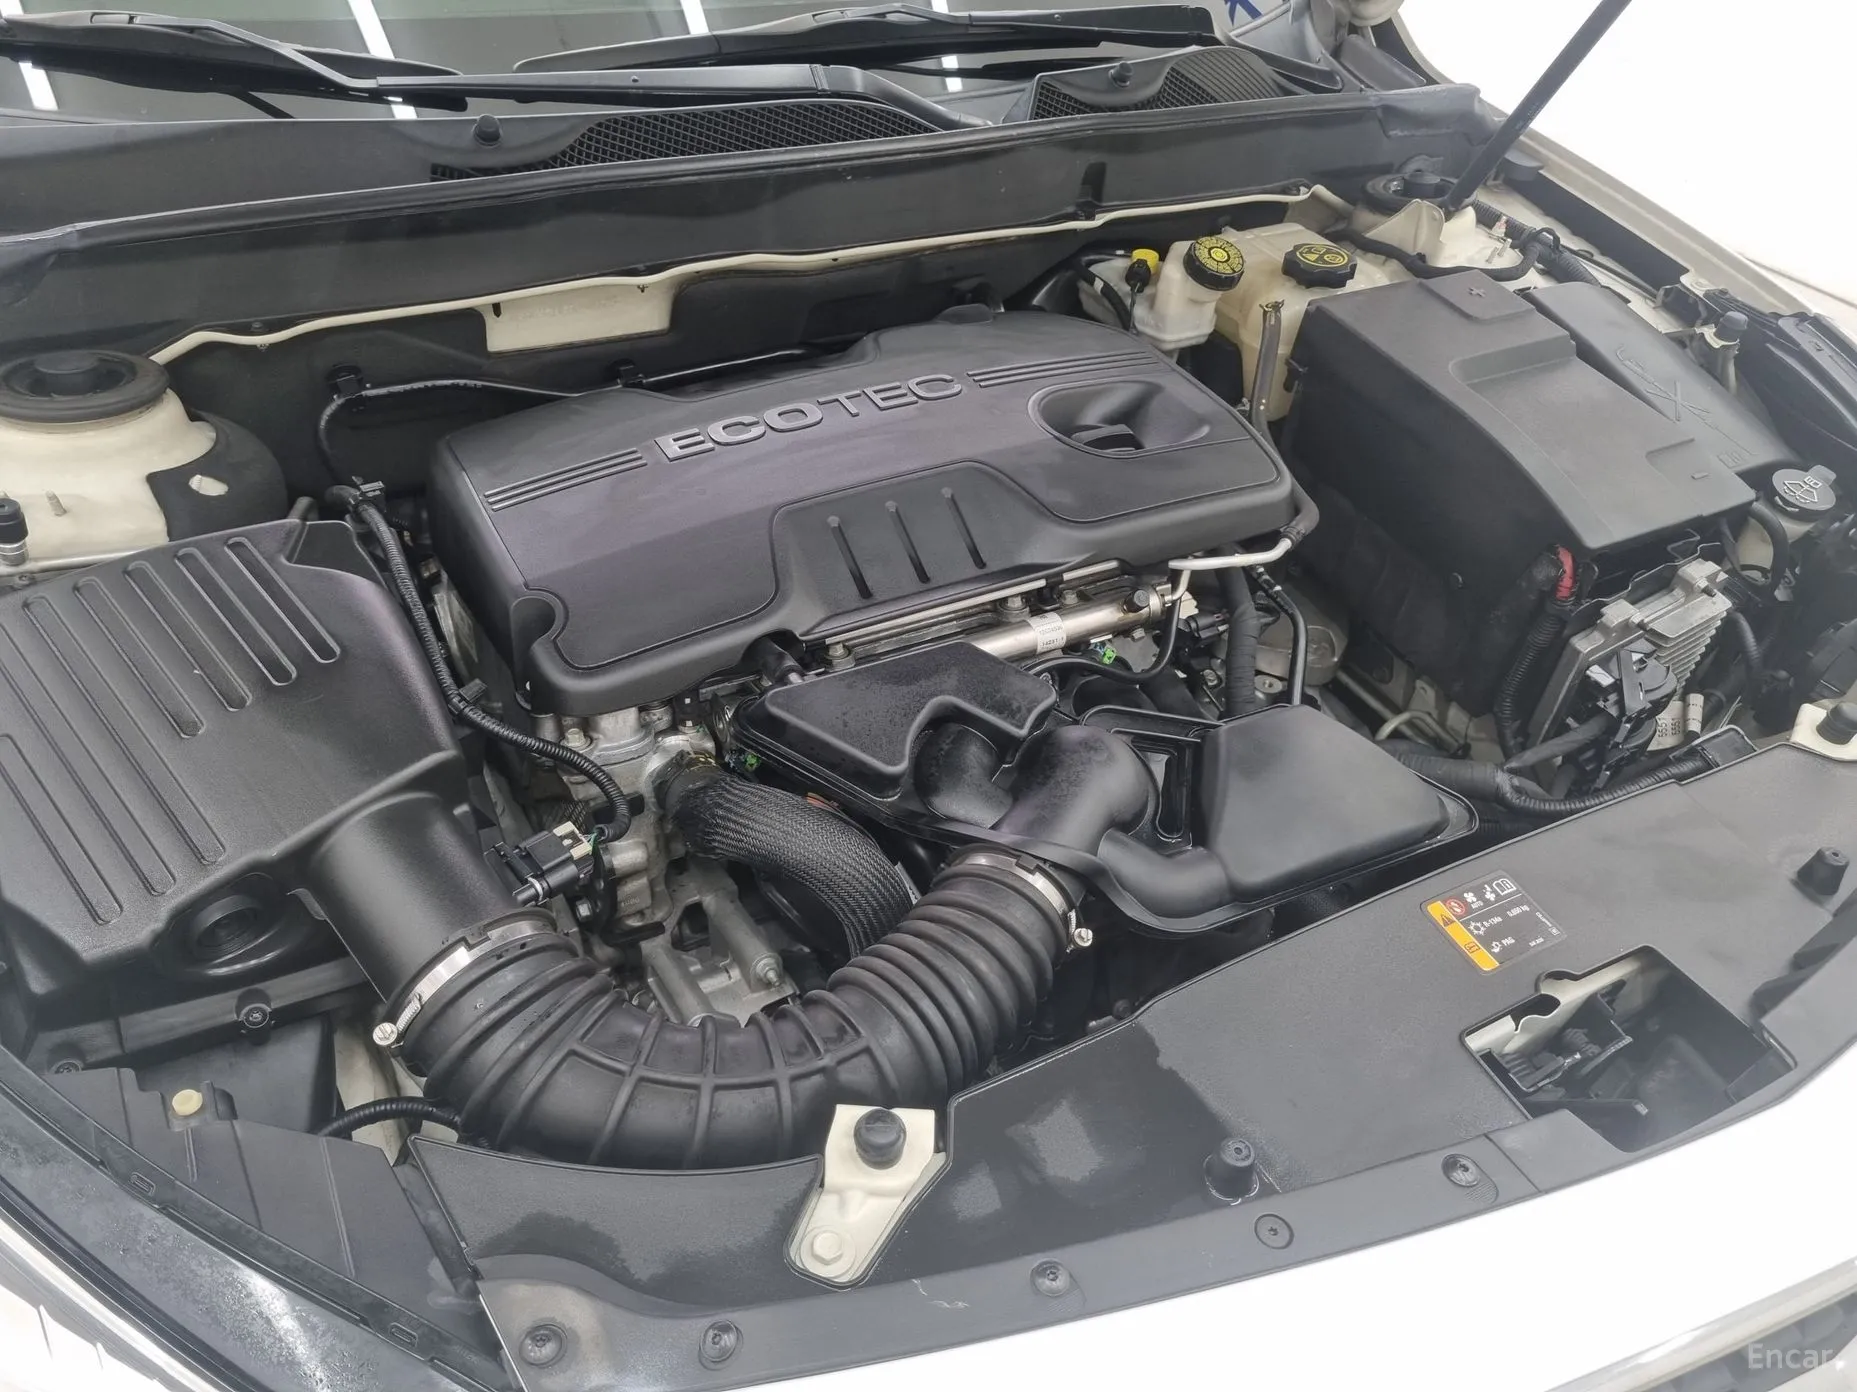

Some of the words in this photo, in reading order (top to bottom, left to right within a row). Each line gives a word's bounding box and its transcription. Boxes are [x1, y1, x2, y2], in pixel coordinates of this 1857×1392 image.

[654, 373, 962, 463] ECOTEC
[1482, 916, 1503, 928] R-134a
[1501, 936, 1516, 946] PAG
